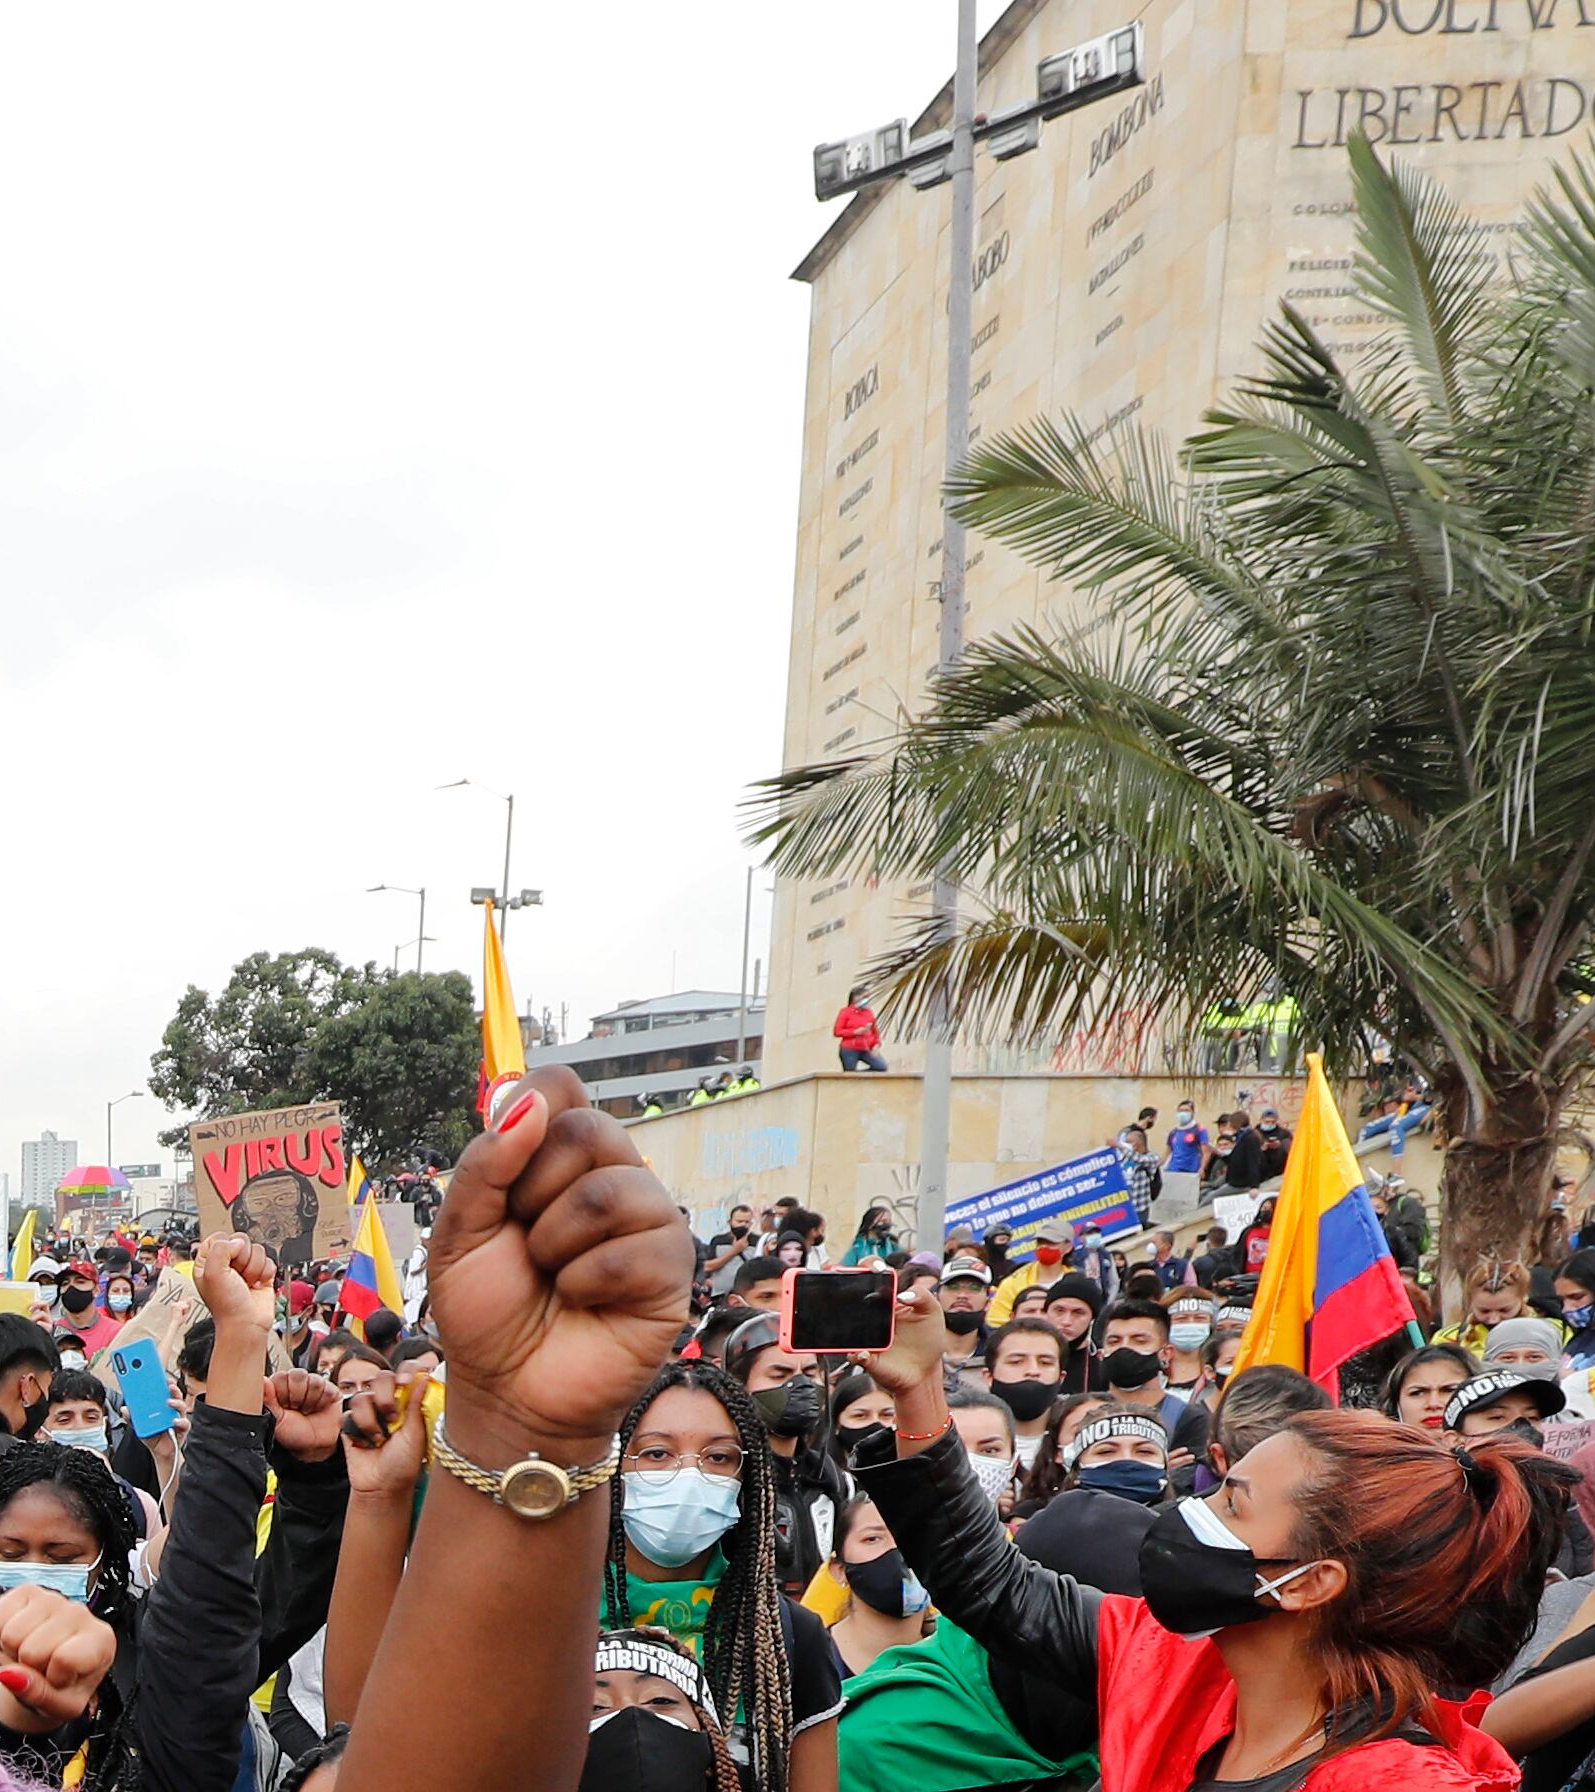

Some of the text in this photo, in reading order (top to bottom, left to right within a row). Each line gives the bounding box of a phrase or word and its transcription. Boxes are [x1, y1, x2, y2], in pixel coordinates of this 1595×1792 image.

[1292, 78, 1595, 149] LIBERTAD
[971, 230, 1010, 293] ABOBO
[215, 1108, 317, 1141] NO HAY PEOR
[203, 1125, 344, 1209] VIRUS
[1458, 1377, 1494, 1409] NO
[1082, 1418, 1111, 1449] NO
[595, 1649, 699, 1702] RIBUTARIA
[627, 1640, 699, 1682] REFORMA
